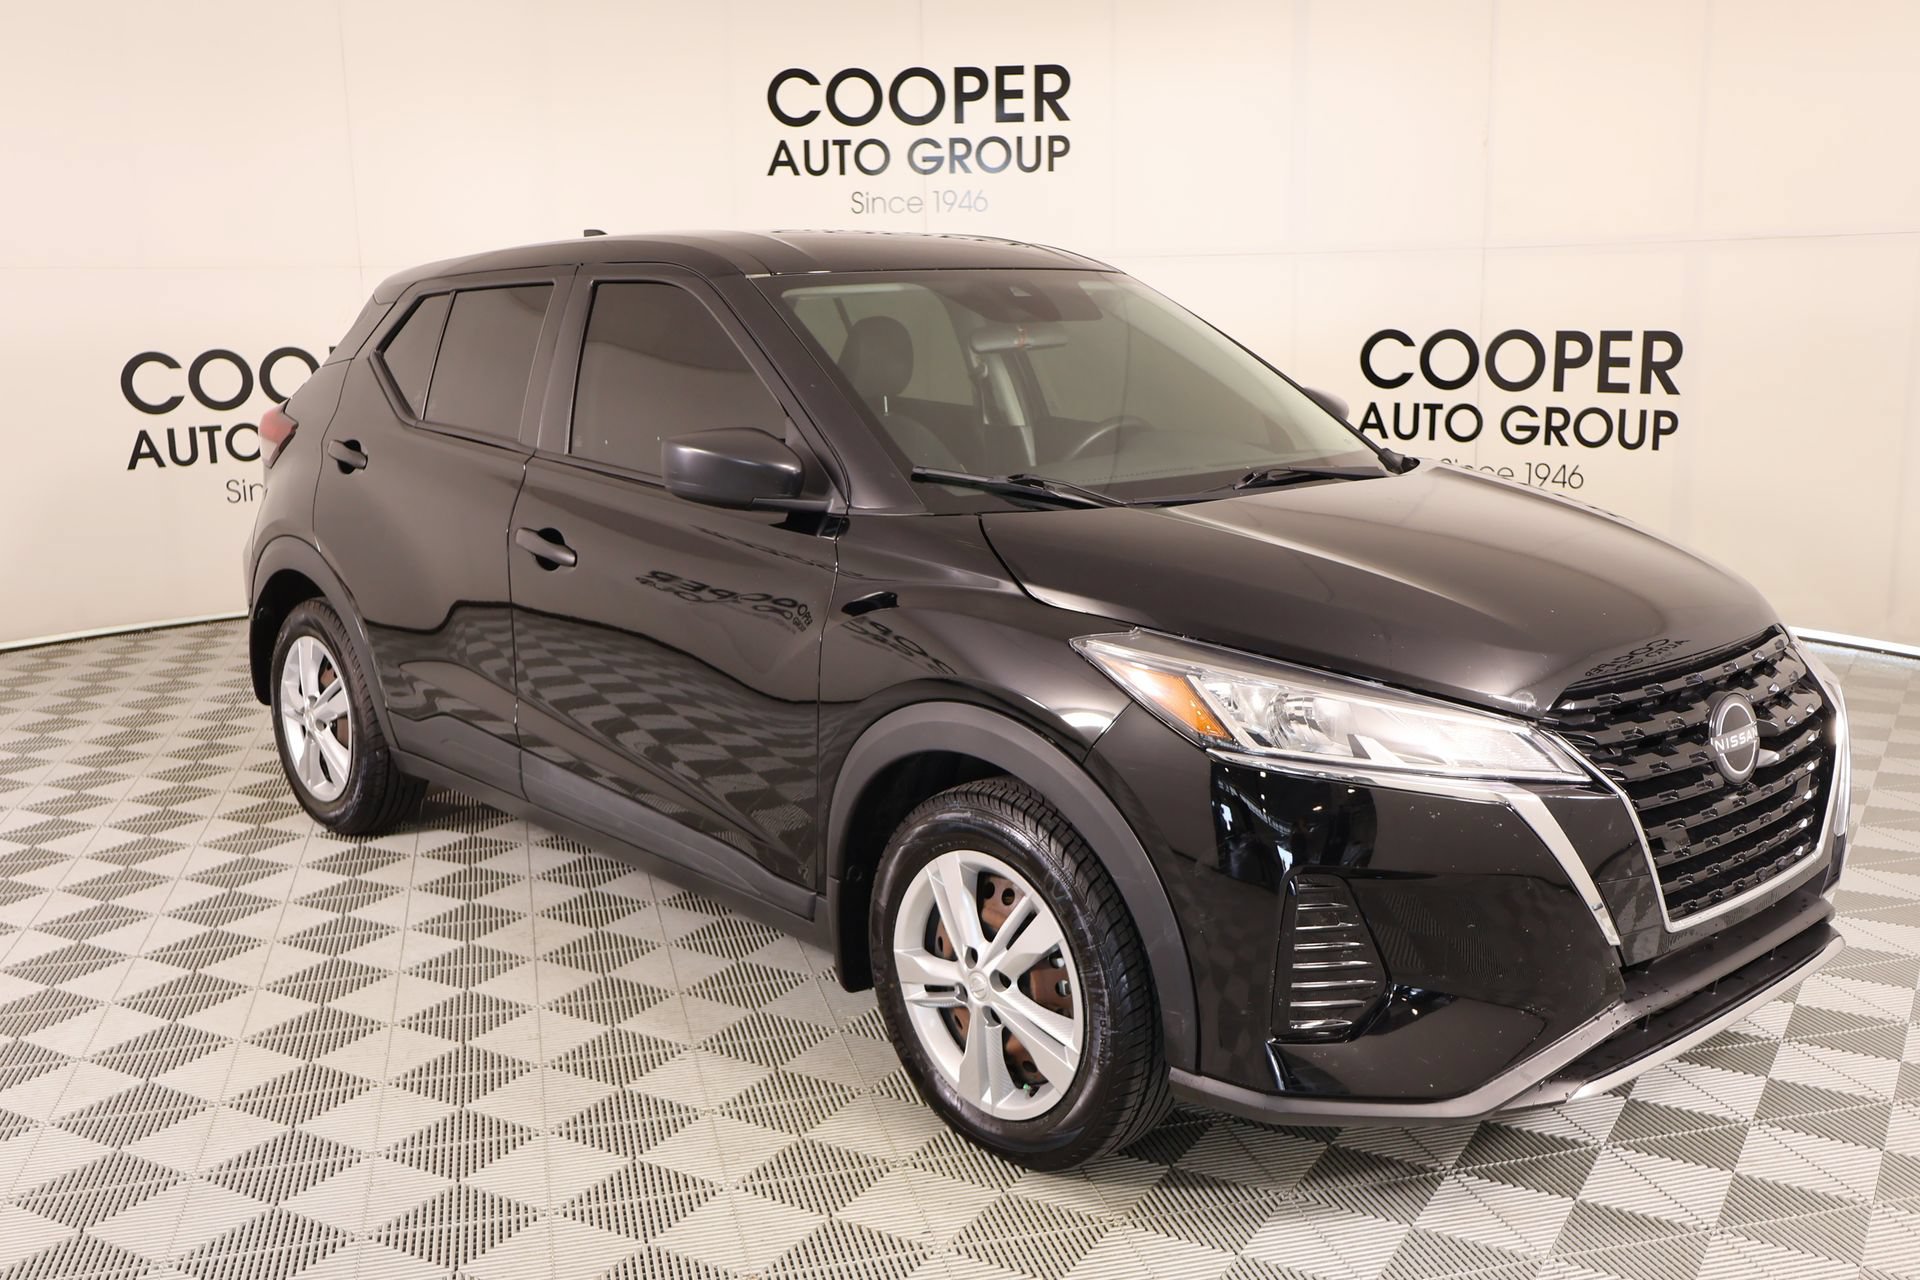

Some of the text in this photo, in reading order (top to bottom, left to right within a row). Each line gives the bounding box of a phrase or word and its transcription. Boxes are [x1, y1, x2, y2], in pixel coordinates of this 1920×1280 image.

[767, 64, 1071, 127] COOPER
[767, 135, 1070, 176] AUTO GROUP
[851, 189, 989, 214] Since 1946
[121, 346, 336, 415] COO
[1360, 329, 1683, 395] COOPER
[127, 422, 262, 470] AUTO
[1358, 402, 1679, 451] AUTO GROUP
[1525, 462, 1584, 489] 1946
[1713, 726, 1758, 752] NISSAN
